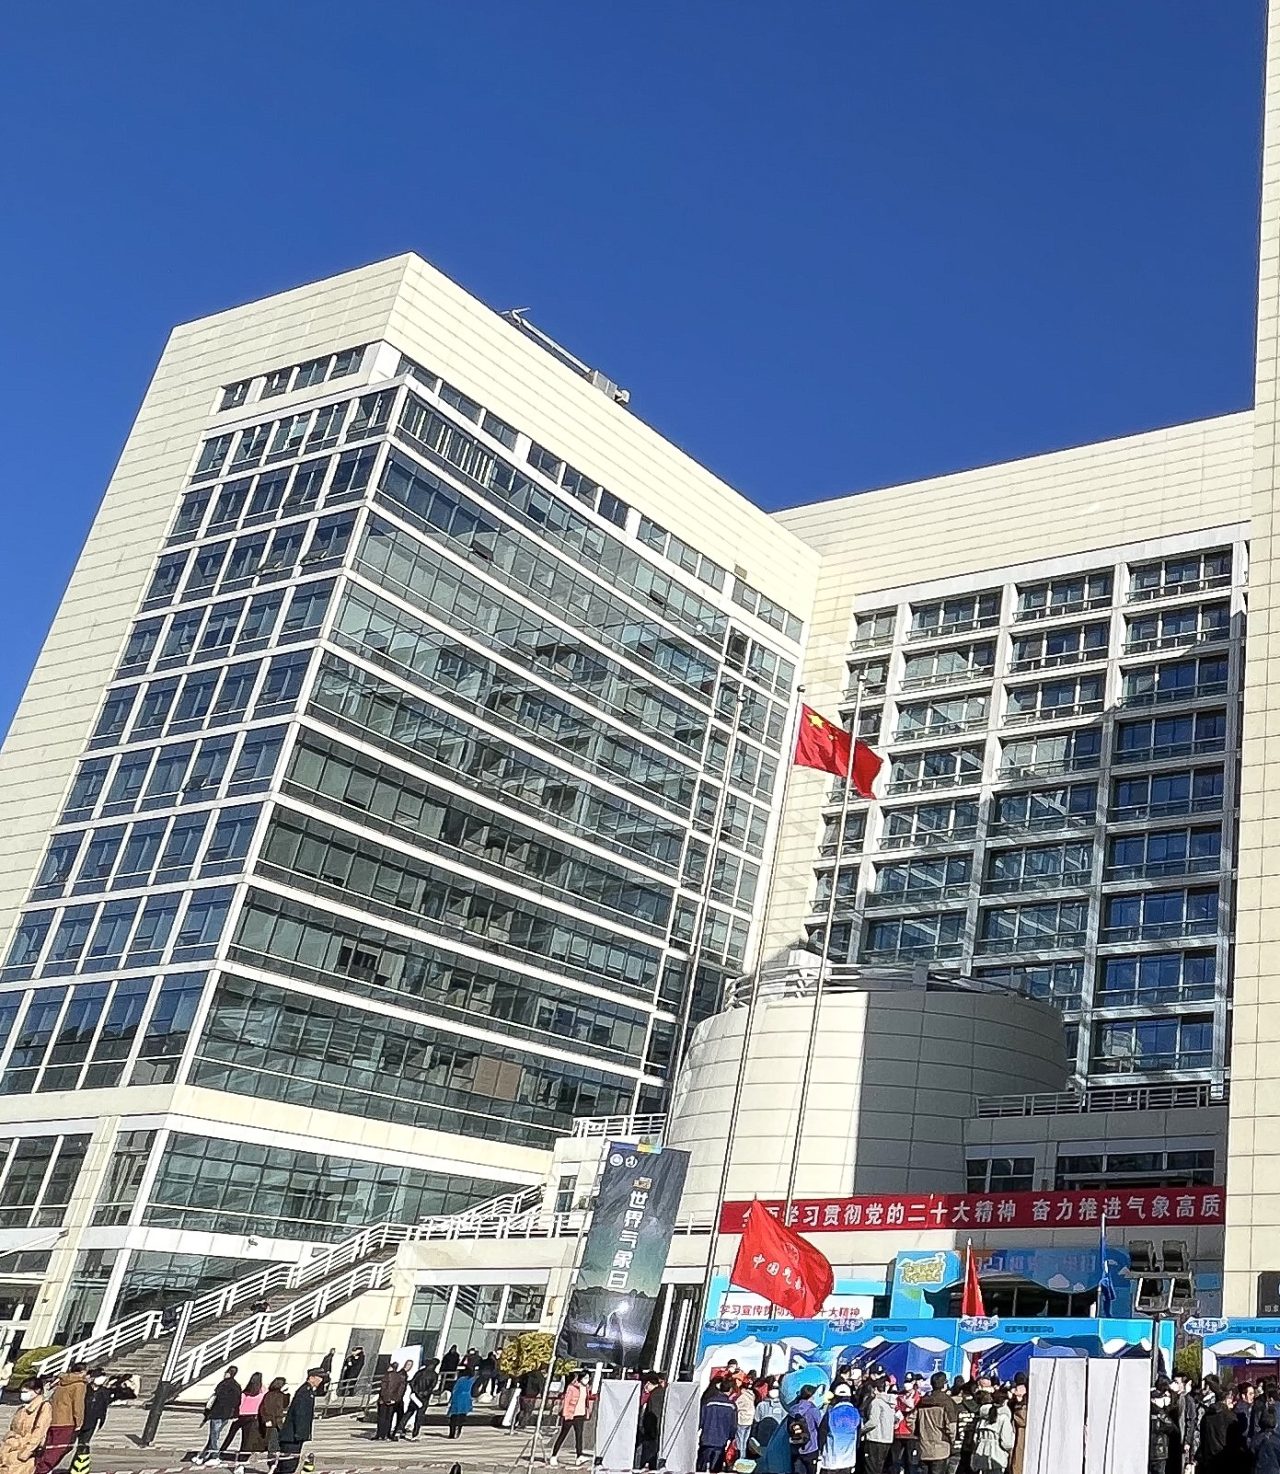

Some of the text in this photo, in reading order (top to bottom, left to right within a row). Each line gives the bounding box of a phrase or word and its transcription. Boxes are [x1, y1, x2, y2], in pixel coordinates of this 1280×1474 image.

[607, 1189, 649, 1289] 世界气象日
[1032, 1193, 1221, 1222] 奋力推进气象高质
